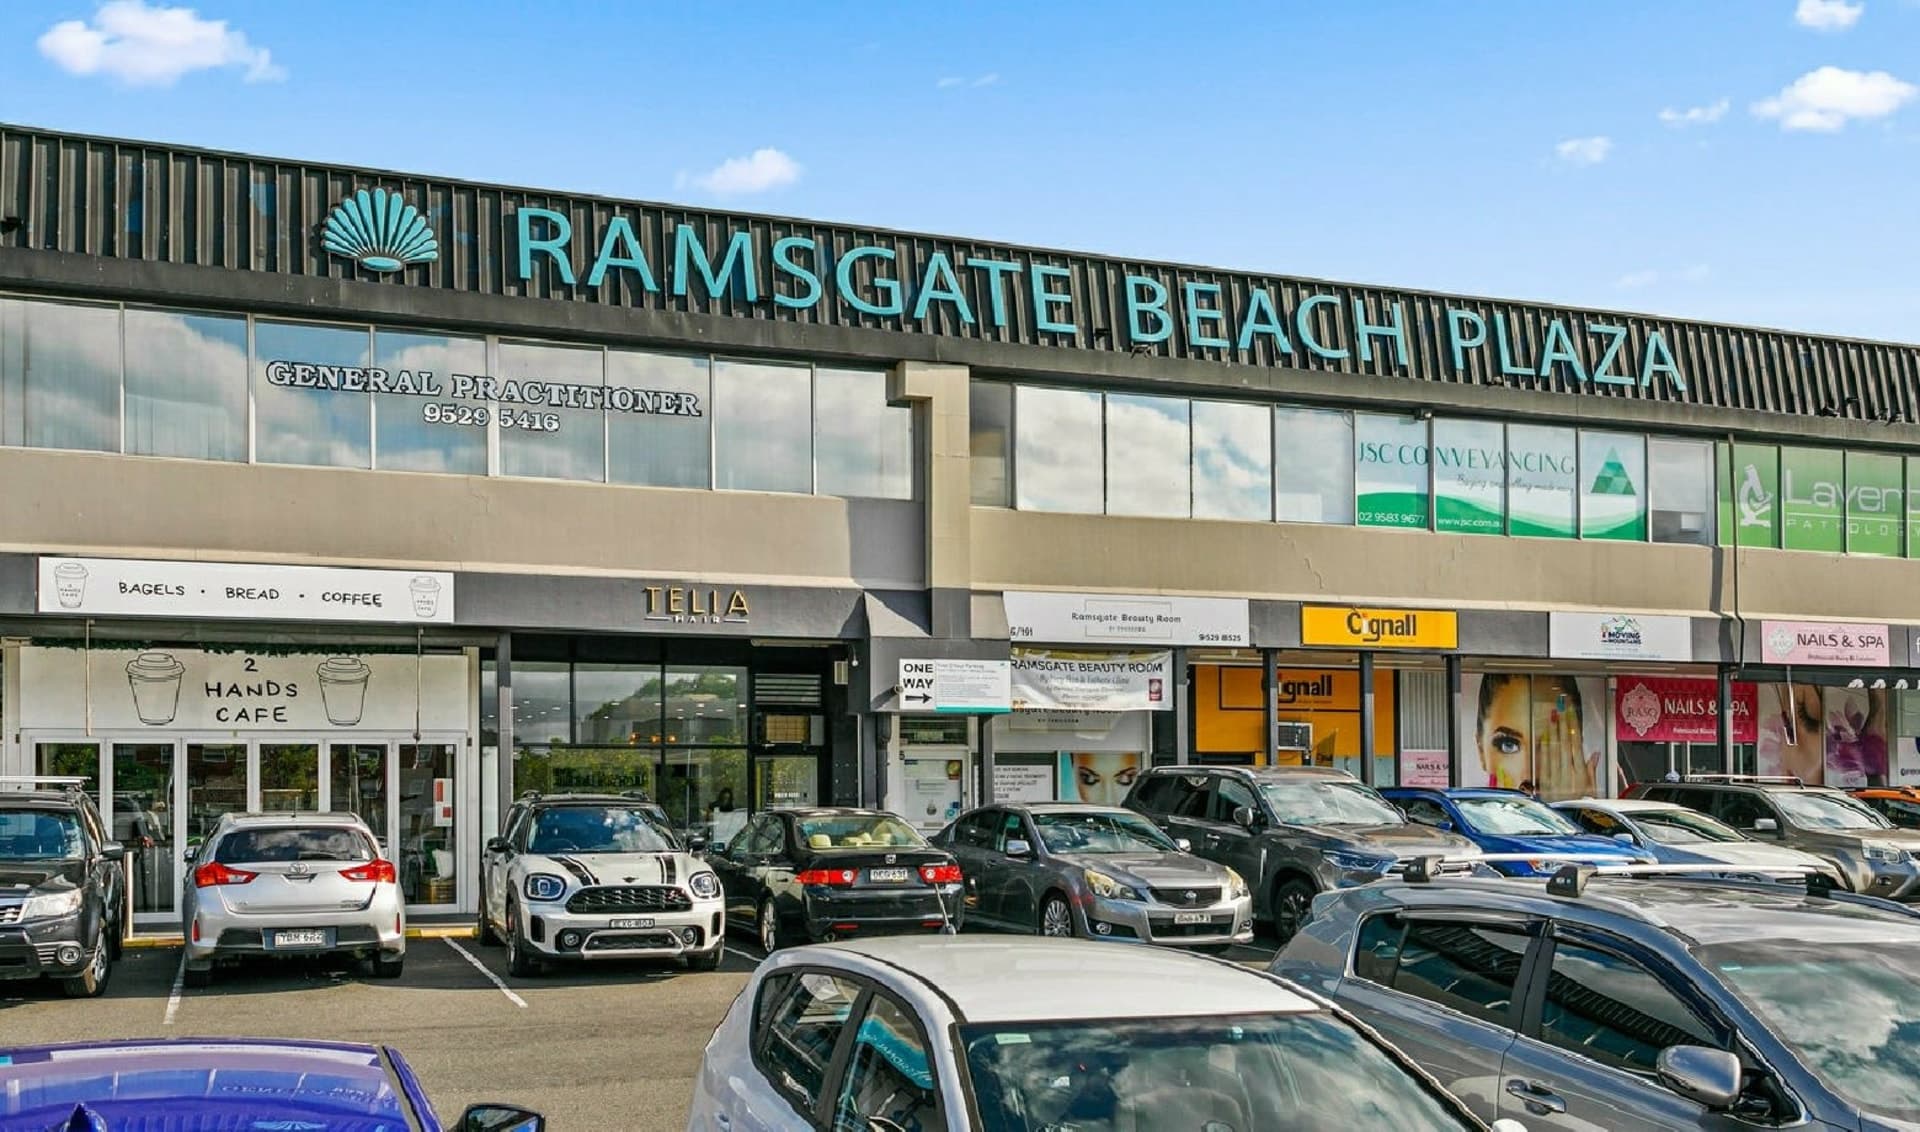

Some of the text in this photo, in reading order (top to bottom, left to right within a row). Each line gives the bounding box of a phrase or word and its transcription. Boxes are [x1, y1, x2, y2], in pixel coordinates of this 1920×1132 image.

[517, 207, 1687, 392] RAMSGATE BEACH PLAZA
[265, 360, 703, 417] GENERAL PRACTITIONER
[423, 402, 561, 432] 9529 5416
[1359, 443, 1575, 475] JSC CONVEYANCING
[1358, 511, 1373, 521] 02
[1401, 514, 1425, 525] 9677
[119, 582, 383, 608] BAGELS BREAD COFFEE
[645, 586, 749, 615] TELIA
[674, 615, 720, 623] HAIR
[1072, 612, 1182, 624] Ramsgate Beauty Room
[1346, 612, 1417, 642] Cignall
[1608, 631, 1641, 639] MOVING
[1797, 633, 1885, 648] NAILS & SPA
[244, 657, 259, 672] 2
[903, 663, 934, 673] ONE
[1011, 659, 1163, 673] RAMSGATE BEAUTY ROOM
[205, 680, 298, 698] HANDS
[903, 678, 934, 689] WAY
[1263, 672, 1333, 704] ignall
[216, 706, 289, 723] CAFE
[1664, 698, 1749, 716] NAILS & PA
